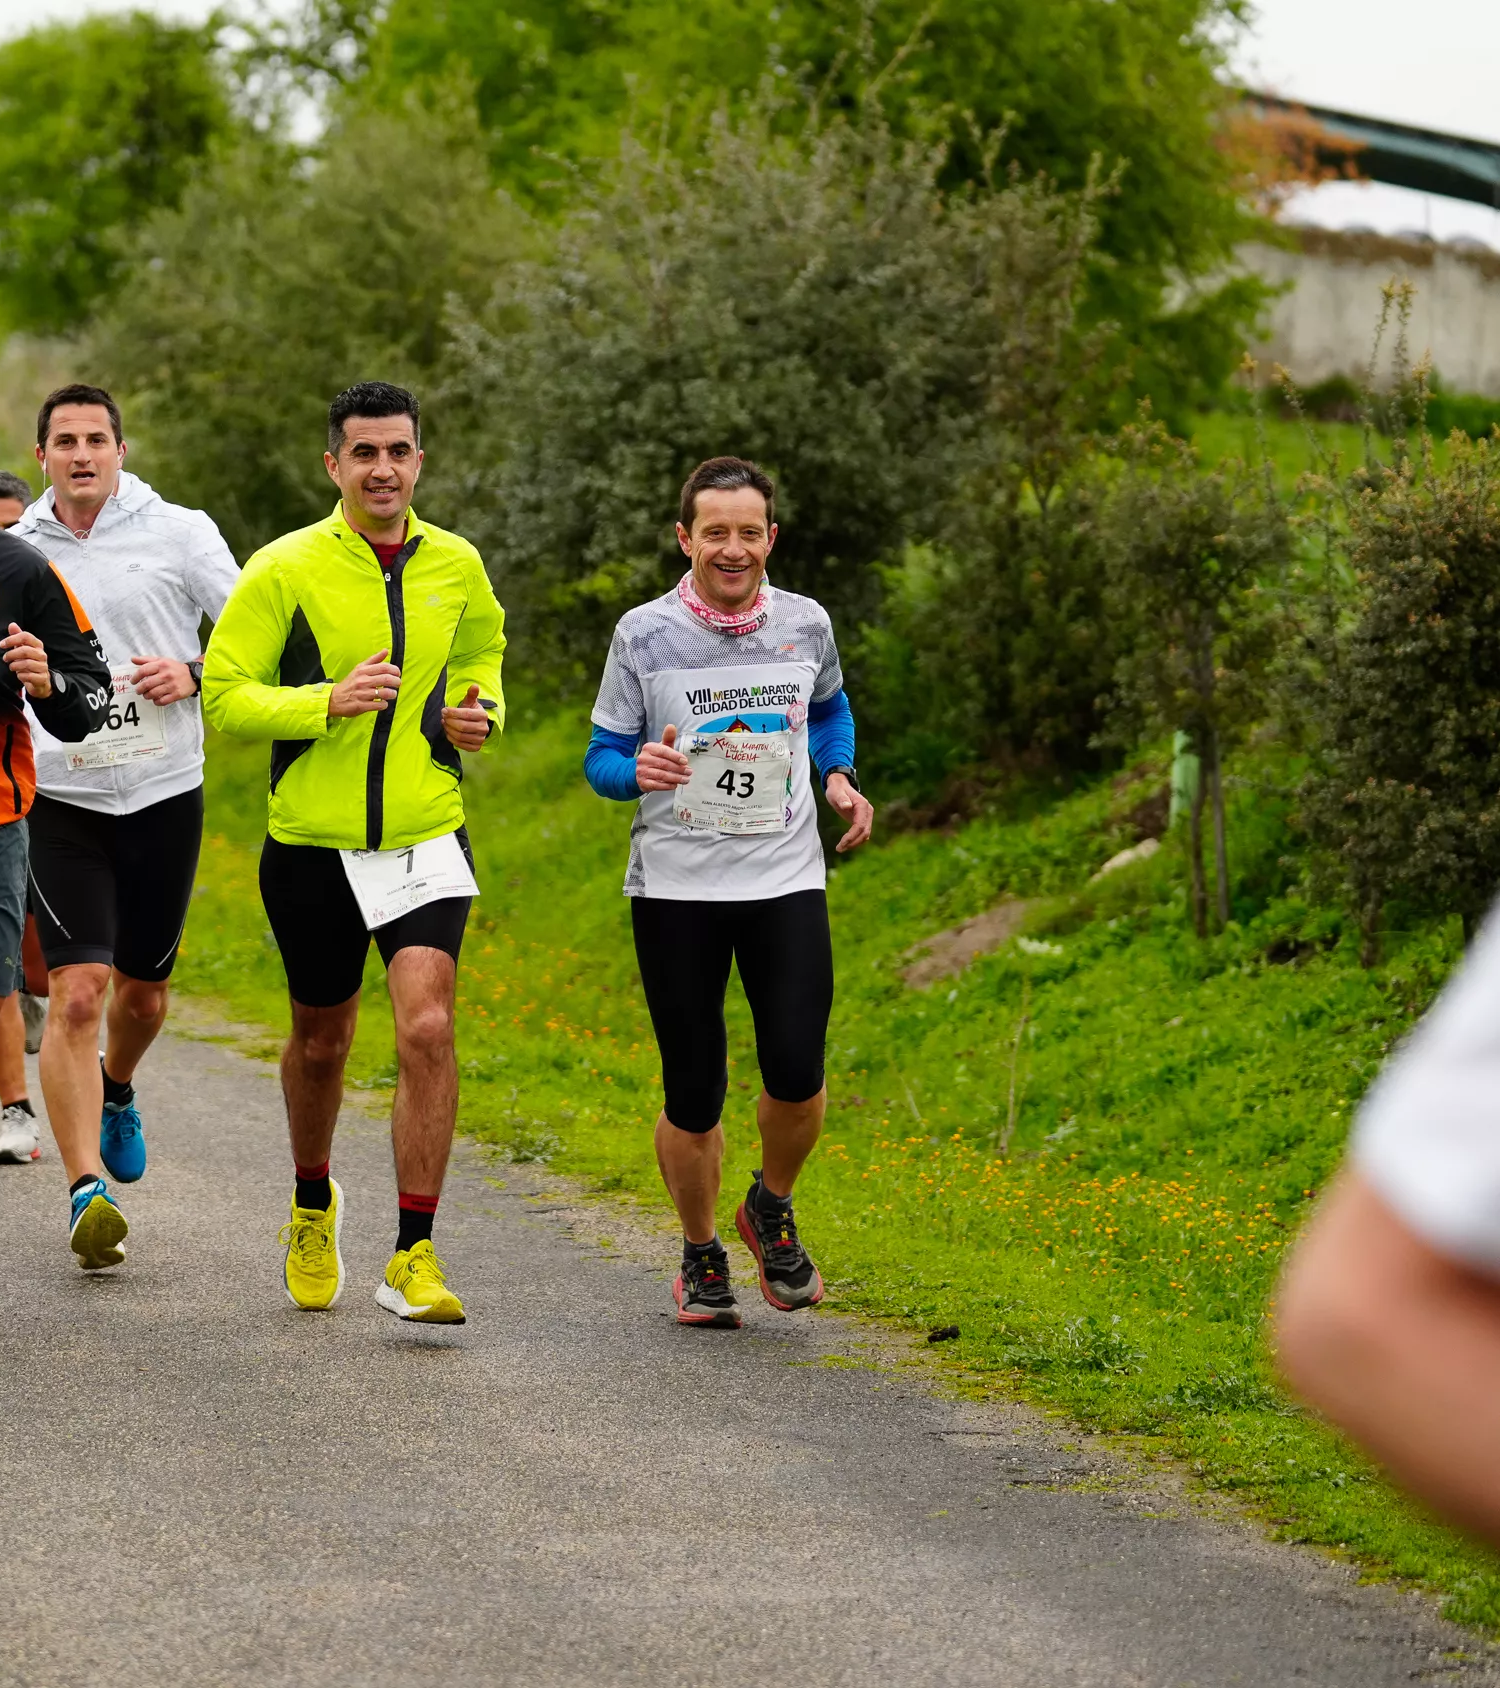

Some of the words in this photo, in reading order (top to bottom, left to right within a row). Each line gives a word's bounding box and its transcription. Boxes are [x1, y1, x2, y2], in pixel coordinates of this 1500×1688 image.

[686, 688, 712, 705] VIII
[713, 688, 749, 701] MEDIA
[751, 682, 800, 697] MARATÓN
[692, 700, 738, 715] CIUDAD
[740, 698, 755, 709] DE
[757, 695, 798, 707] LUCENA
[725, 750, 760, 762] LUCENA
[716, 769, 755, 798] 43
[396, 848, 414, 874] 7
